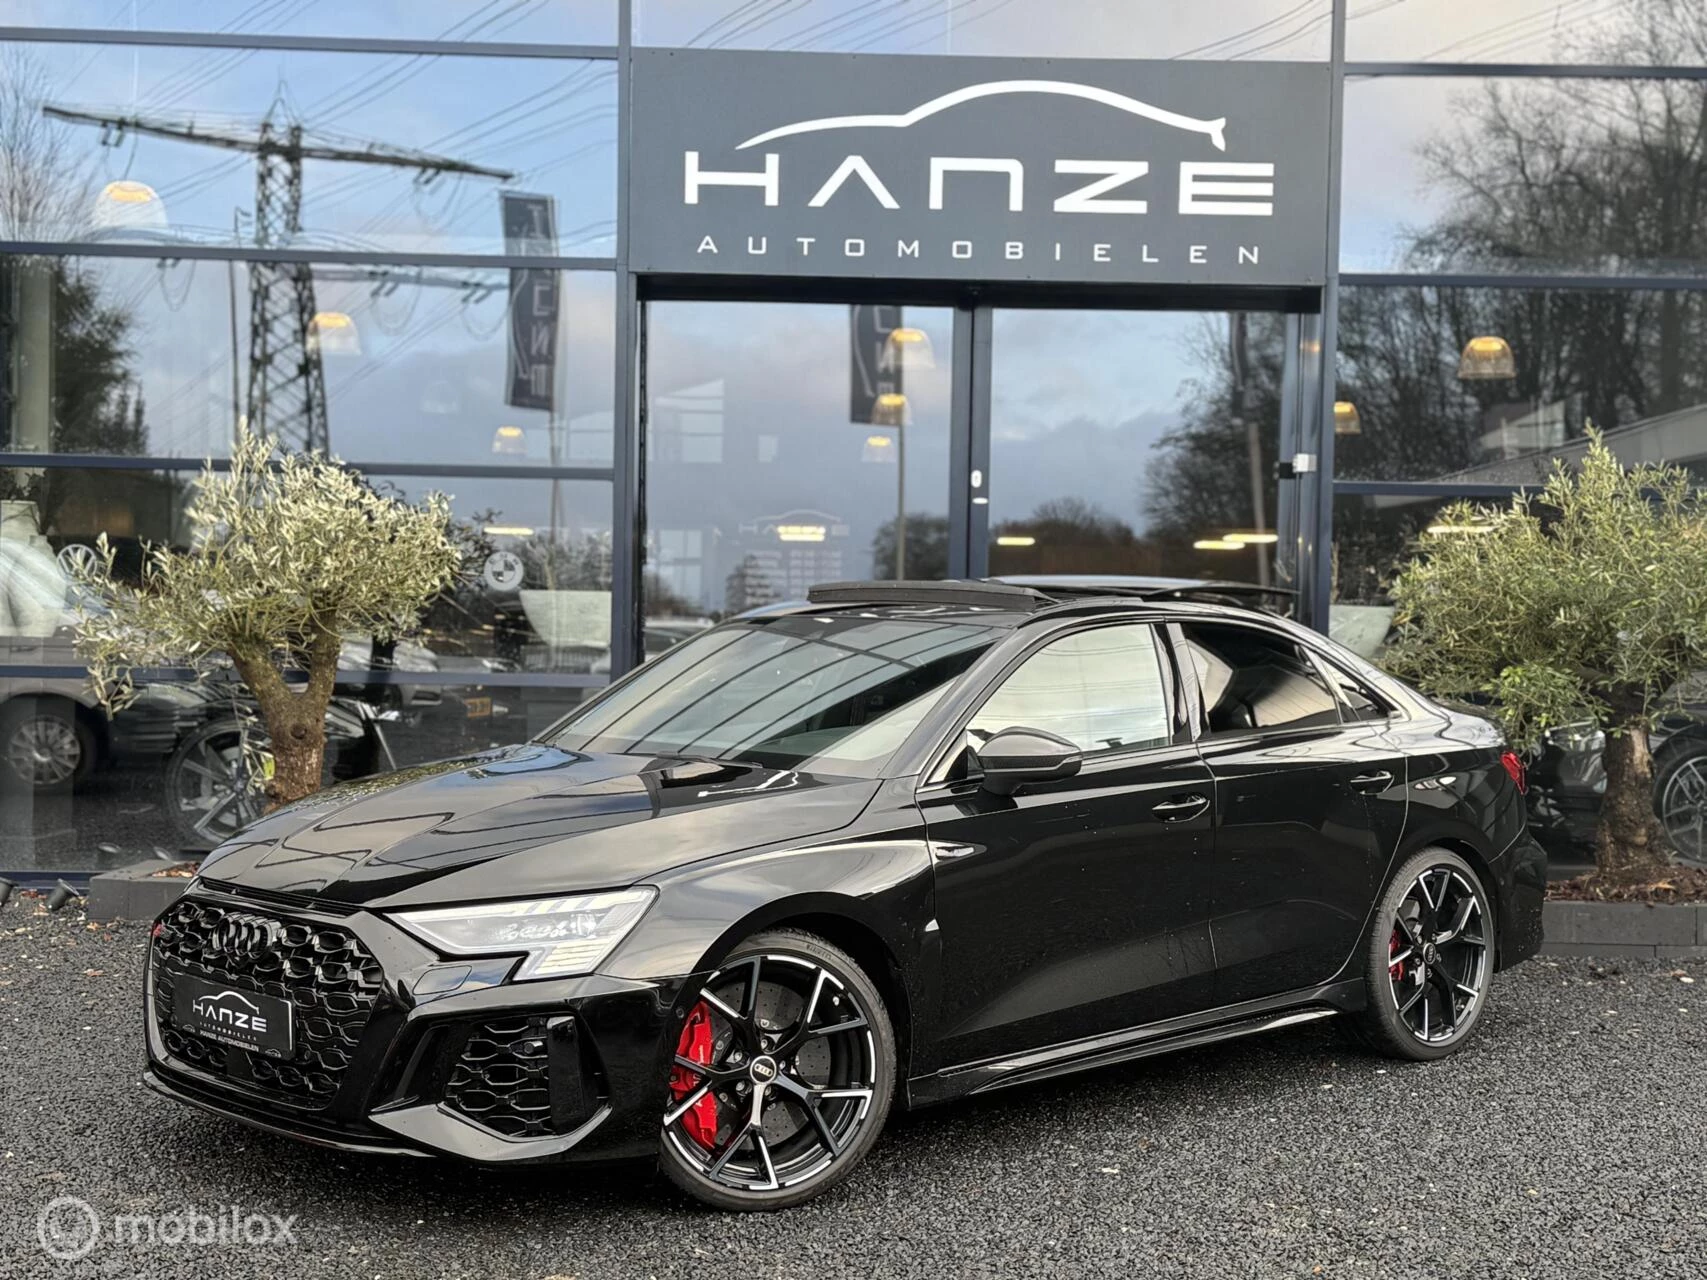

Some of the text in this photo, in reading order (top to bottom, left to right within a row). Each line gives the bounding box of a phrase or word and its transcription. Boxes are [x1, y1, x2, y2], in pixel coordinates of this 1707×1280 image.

[684, 151, 1275, 216] HANZE
[696, 235, 1260, 265] AUTOMOBIELEN
[192, 999, 267, 1033] HANZE
